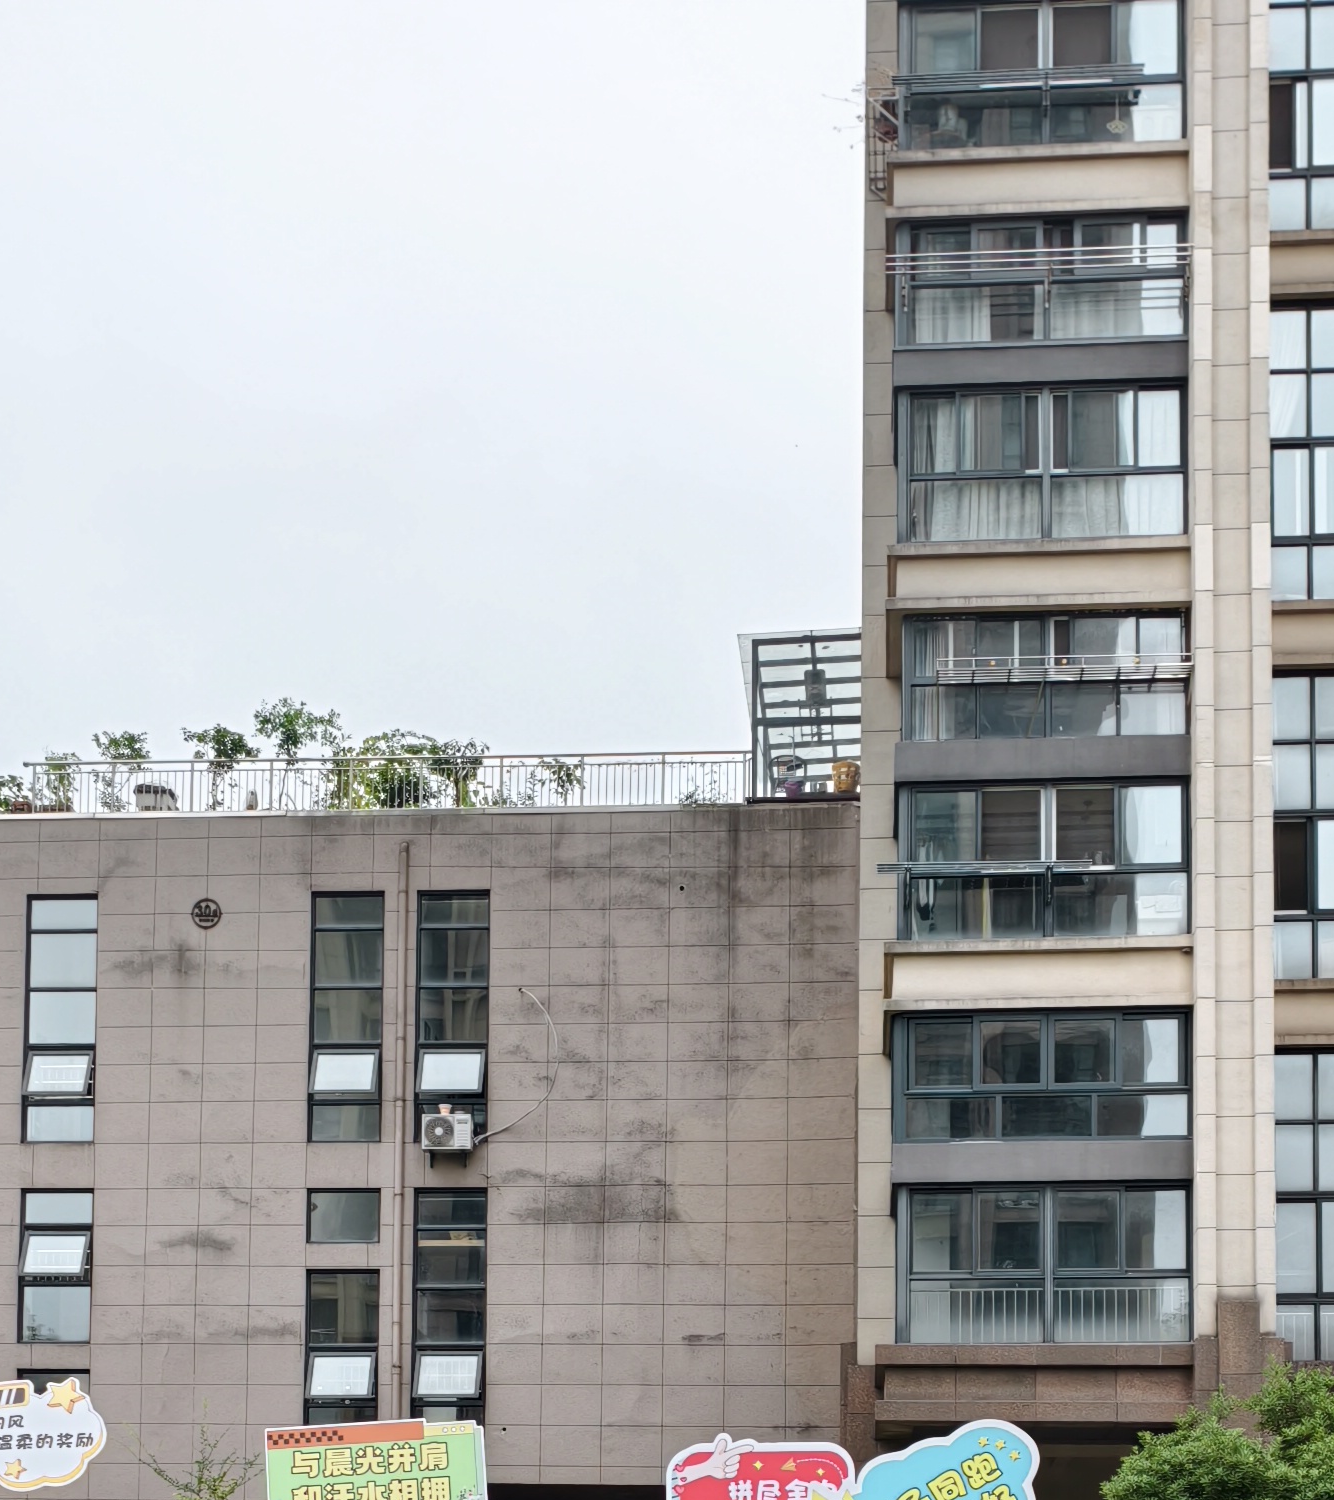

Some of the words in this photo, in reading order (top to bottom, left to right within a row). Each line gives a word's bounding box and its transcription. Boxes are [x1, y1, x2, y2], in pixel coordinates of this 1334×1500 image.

[291, 1441, 450, 1479] 与晨光并肩
